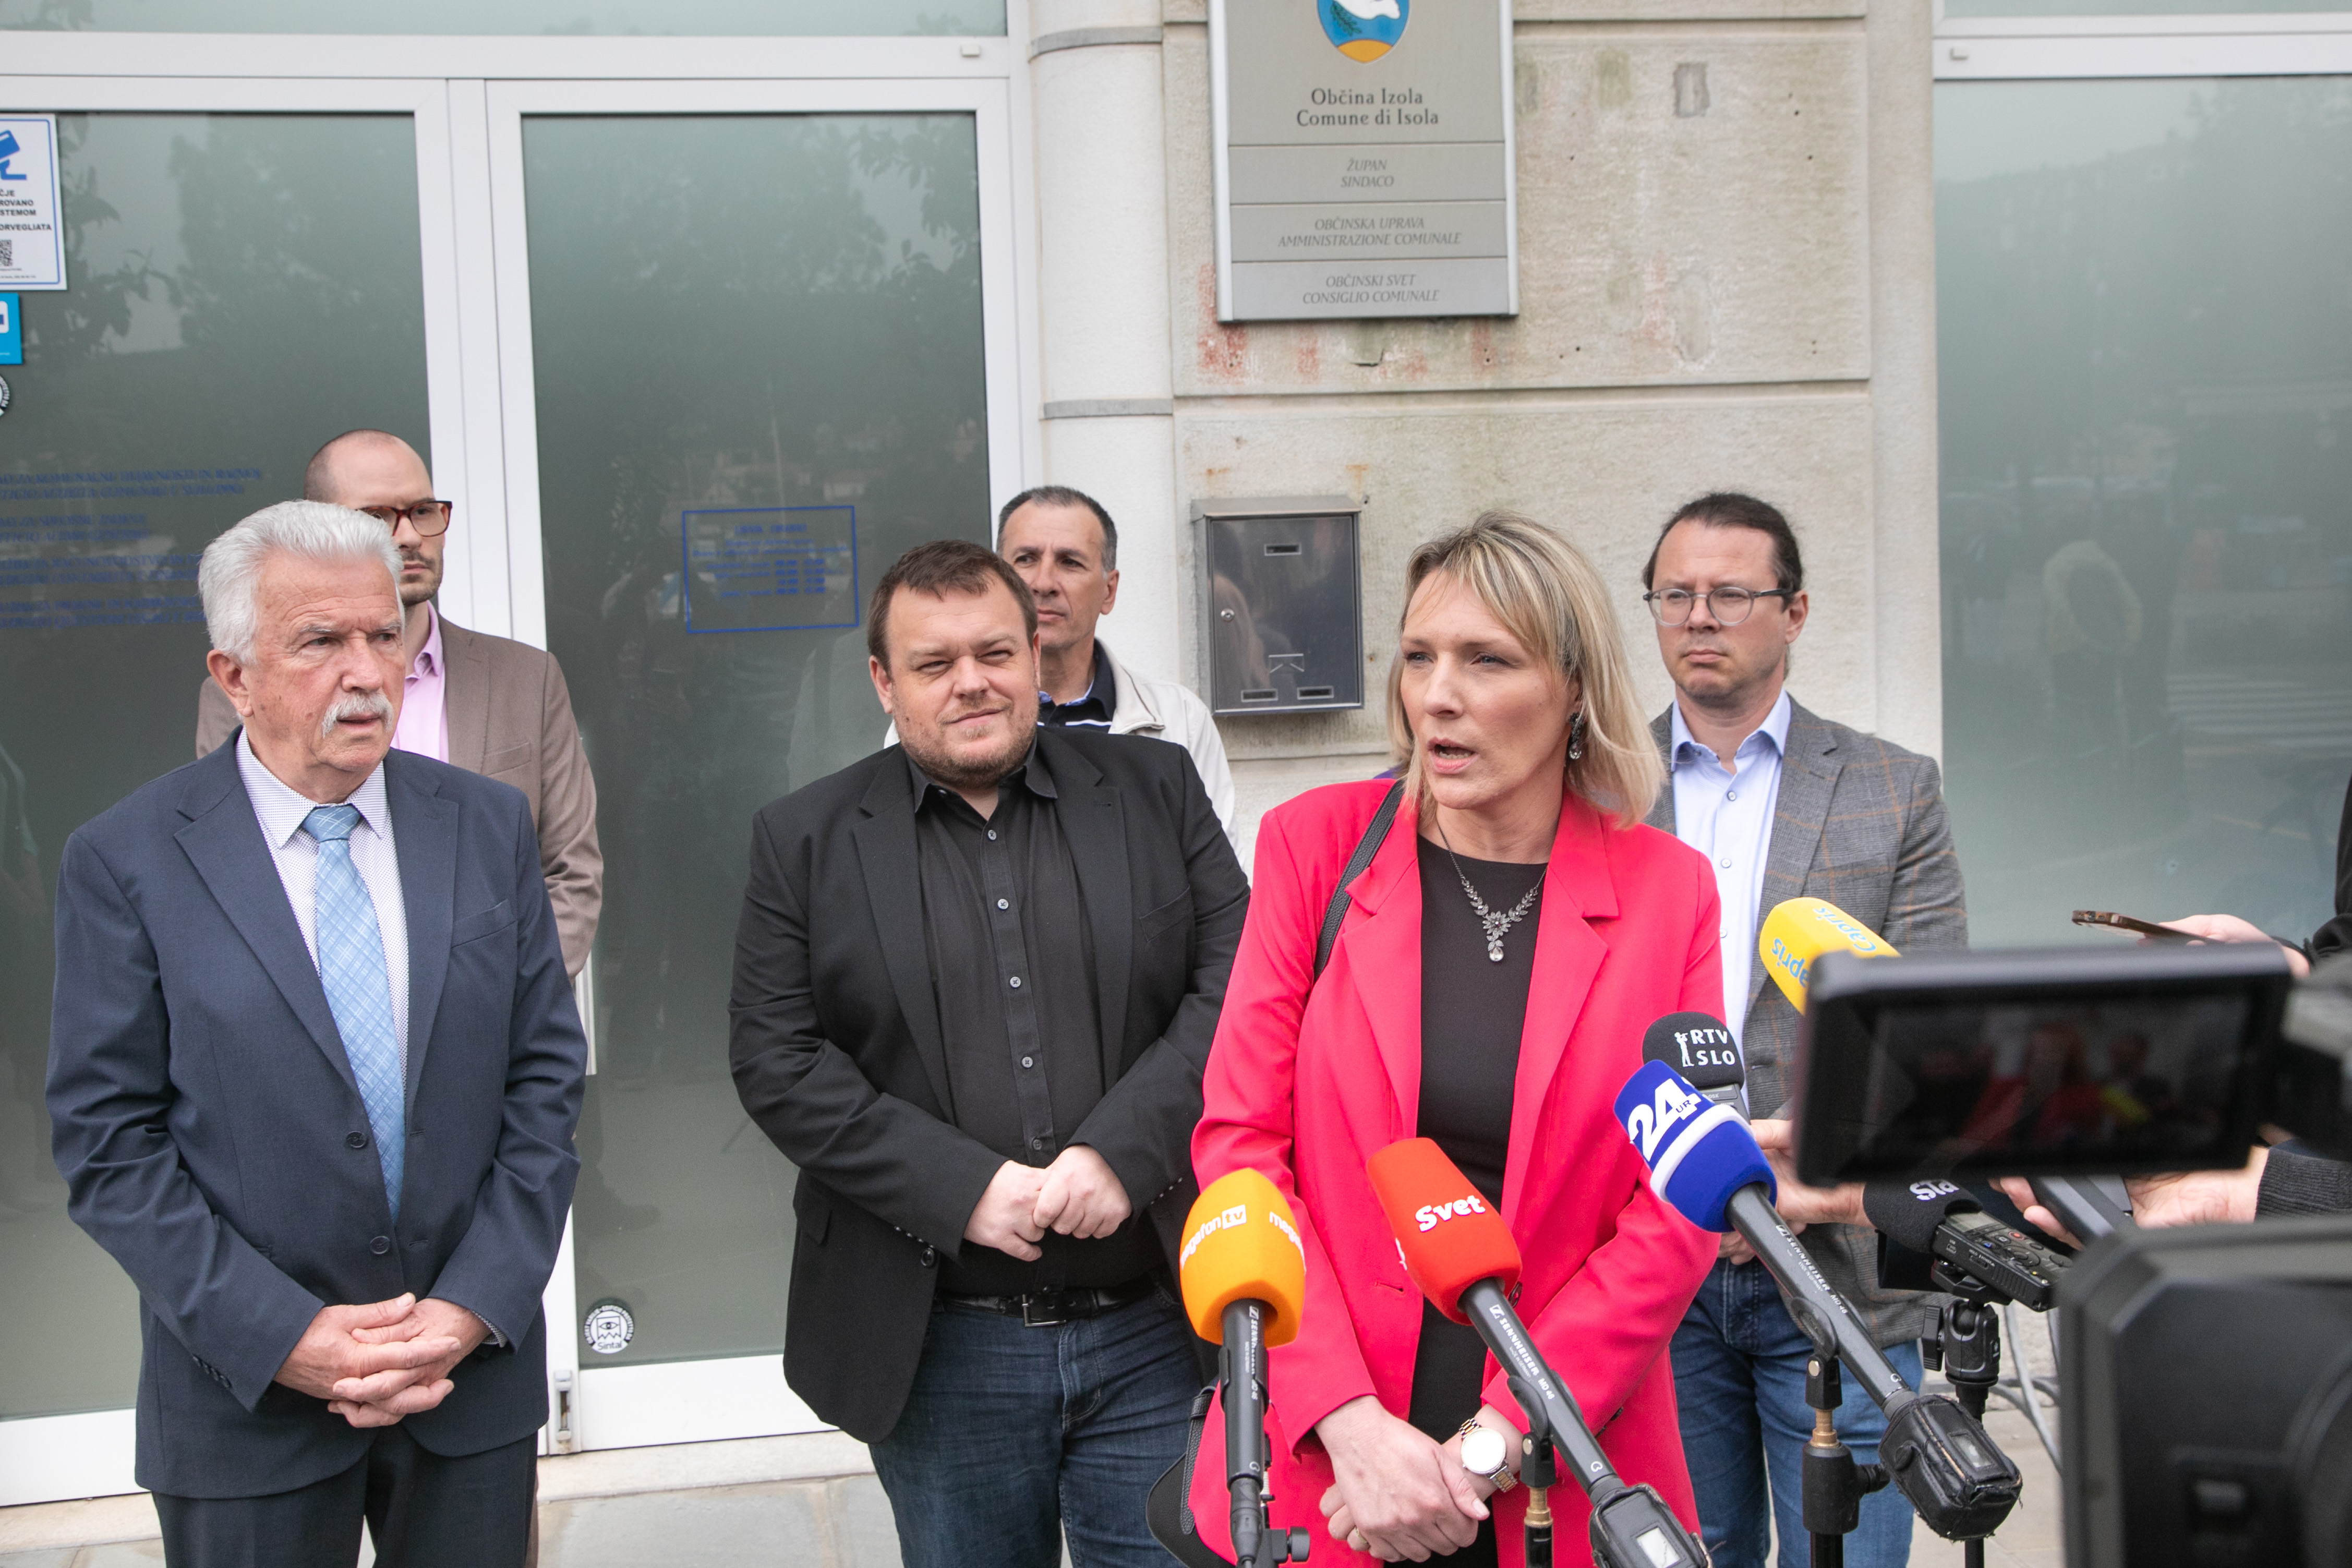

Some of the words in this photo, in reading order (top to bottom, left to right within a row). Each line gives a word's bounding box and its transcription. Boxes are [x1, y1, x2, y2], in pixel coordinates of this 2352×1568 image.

[1311, 88, 1374, 105] Občina
[1381, 88, 1423, 104] Izola
[1297, 110, 1369, 126] Comune
[1376, 108, 1391, 125] di
[1398, 108, 1439, 125] Isola
[1346, 158, 1388, 171] ŽUPAN
[1340, 175, 1394, 188] SINDACO
[1314, 215, 1376, 230] OBČINSKA
[1380, 216, 1425, 229] UPRAVA
[1278, 233, 1391, 247] AMMINISTRAZIONE
[1394, 232, 1462, 245] COMUNALE
[1325, 273, 1383, 288] OBČINSKI
[1386, 274, 1417, 286] SVET
[1303, 291, 1369, 304] CONSIGLIO
[1372, 289, 1440, 303] COMUNALE
[1813, 907, 1876, 951] Capris
[1771, 938, 1810, 987] apris
[1691, 1029, 1728, 1045] RTV
[1696, 1050, 1736, 1066] SLO
[1415, 1195, 1486, 1233] Svet
[1786, 1237, 1830, 1291] SENNHEISER
[1830, 1294, 1842, 1305] MD
[1499, 1318, 1540, 1376] SENNHEISER
[1538, 1378, 1550, 1391] MD
